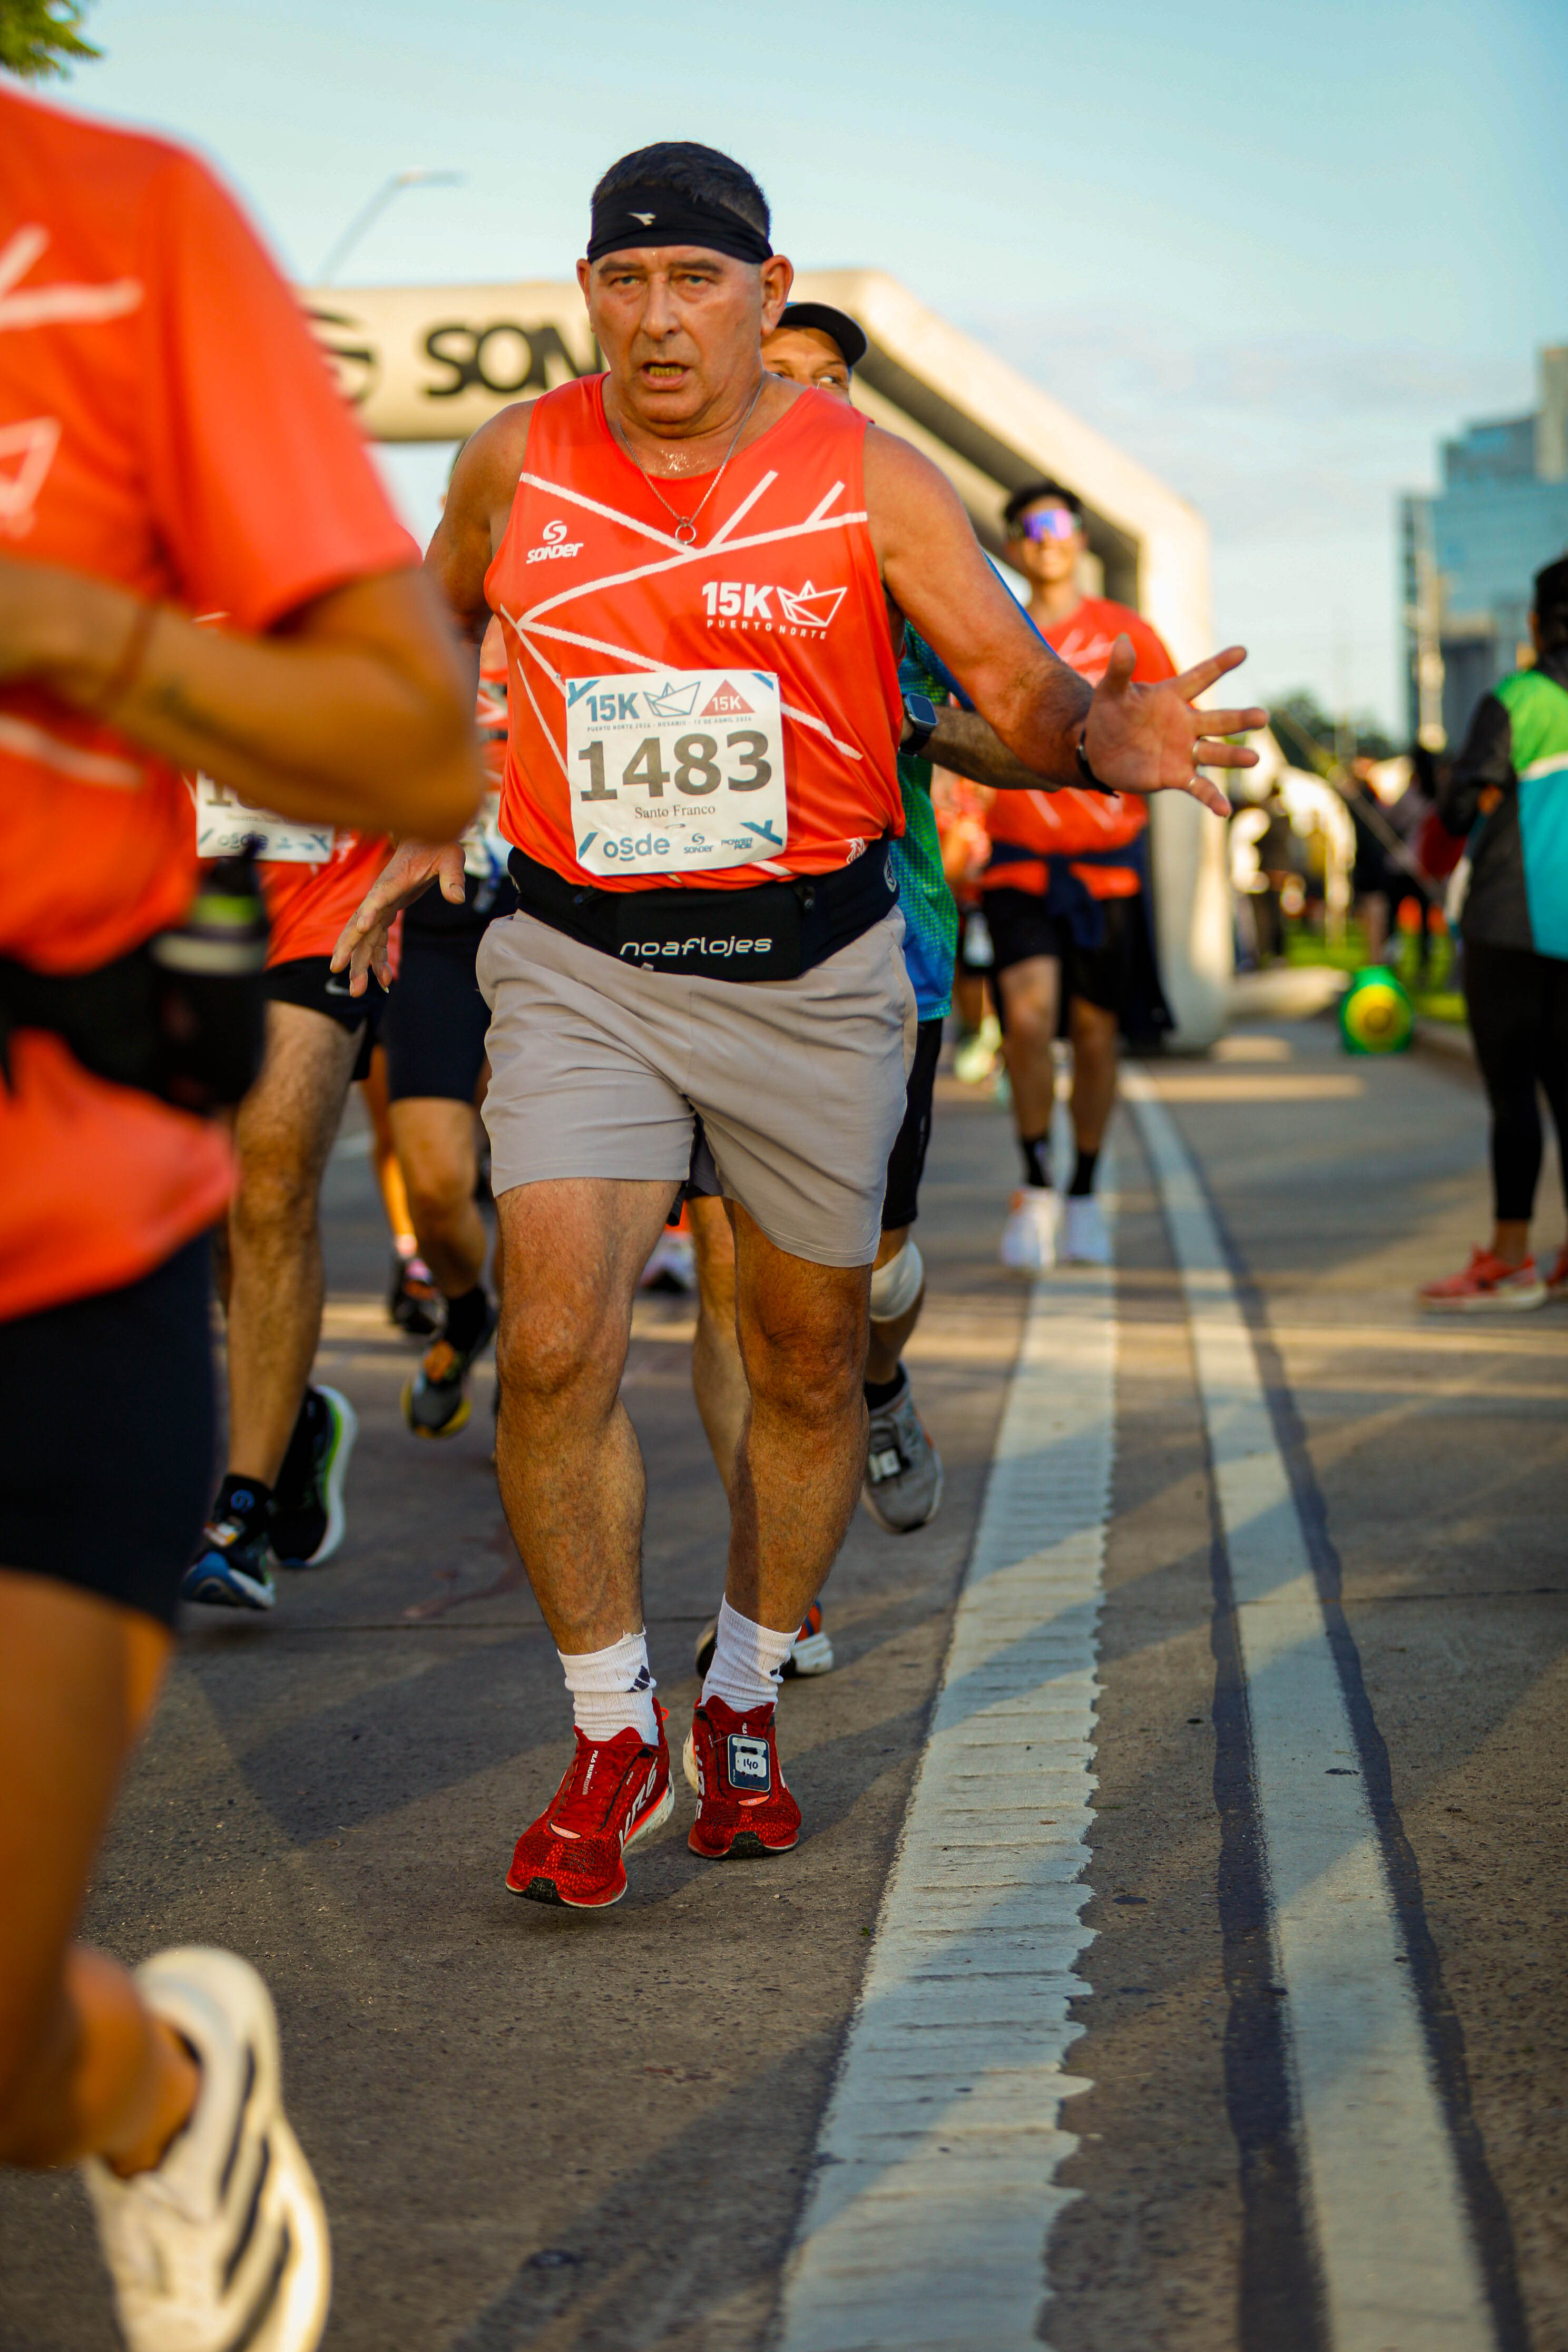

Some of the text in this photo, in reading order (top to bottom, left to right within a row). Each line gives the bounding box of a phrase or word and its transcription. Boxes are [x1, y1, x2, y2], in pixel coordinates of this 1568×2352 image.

[702, 581, 774, 619] 15K
[707, 619, 827, 640] PUERTO NORTE
[585, 691, 640, 722] 15K
[712, 695, 742, 712] 15K
[578, 730, 772, 802] 1483
[634, 804, 716, 819] Santo Franco
[603, 832, 670, 859] osde
[619, 936, 772, 957] noaflojes
[590, 1749, 599, 1763] FILA
[743, 1758, 759, 1770] 140
